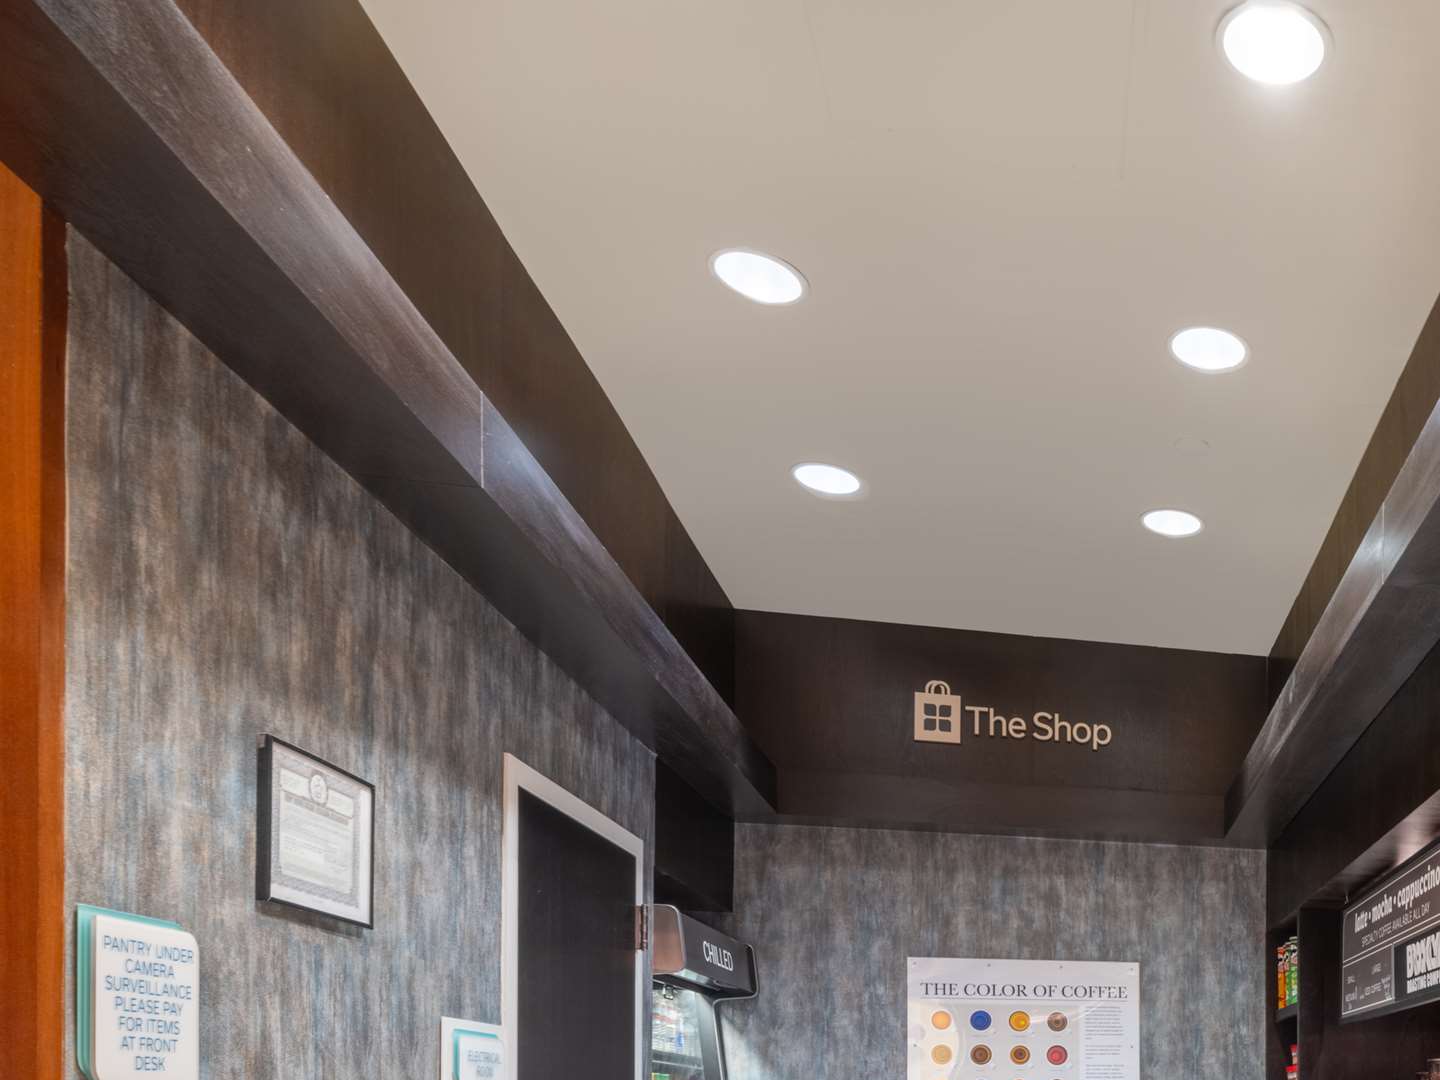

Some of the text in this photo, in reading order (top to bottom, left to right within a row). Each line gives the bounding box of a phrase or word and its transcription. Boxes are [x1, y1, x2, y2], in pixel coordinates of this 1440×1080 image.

[965, 705, 1112, 750] The Shop
[1397, 865, 1440, 909] cappuccino
[103, 935, 194, 963] PANTRY UNDER
[702, 940, 734, 972] CHILLED
[125, 958, 175, 978] CAMERA
[104, 975, 192, 1000] SURVEILLANCE
[920, 982, 1128, 999] THE COLOR OF COFFEE
[114, 996, 184, 1016] PLEASE PAY
[118, 1016, 181, 1035] FOR ITEMS
[120, 1036, 178, 1052] AT FRONT
[135, 1056, 166, 1071] DESK
